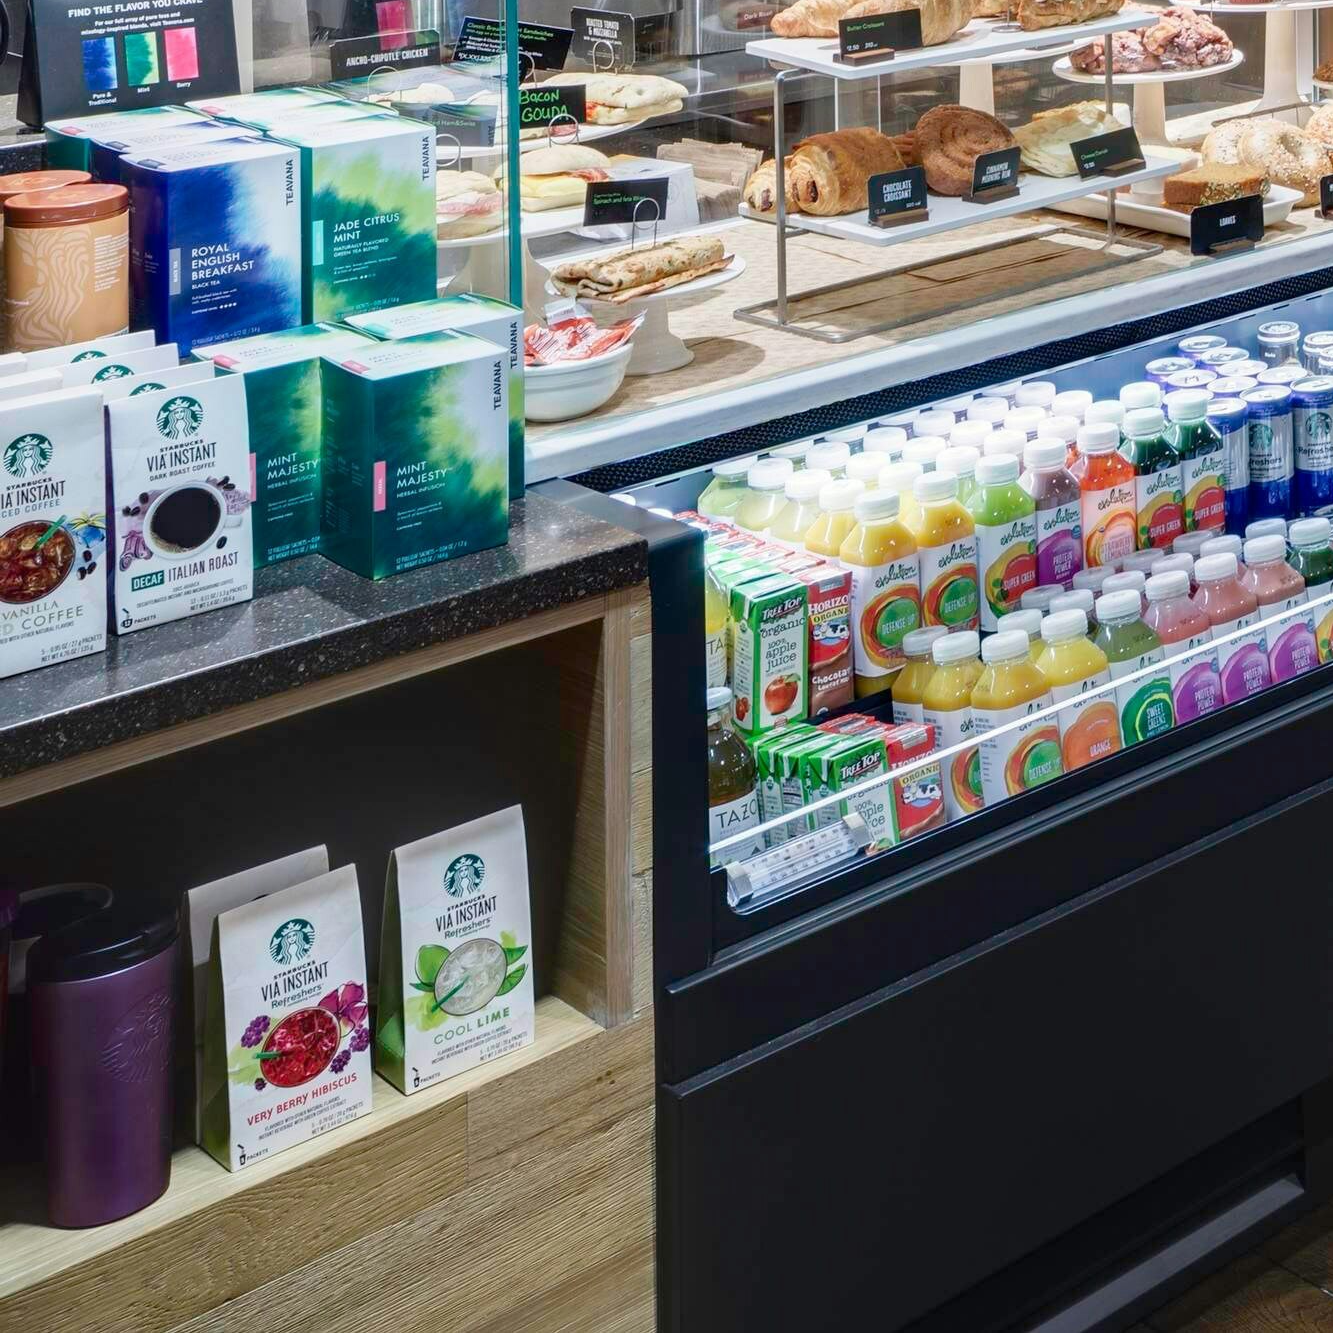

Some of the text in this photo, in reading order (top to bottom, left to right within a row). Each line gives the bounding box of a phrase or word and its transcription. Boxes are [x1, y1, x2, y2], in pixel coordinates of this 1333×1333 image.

[68, 8, 91, 18] FIND
[94, 5, 112, 15] THE
[115, 1, 150, 13] FLAVOR
[401, 47, 429, 59] CHICKEN
[522, 105, 569, 122] GOUDA
[422, 136, 430, 181] TEAVANA
[286, 159, 294, 205] TEAVANA
[882, 179, 912, 193] CHOCOLATE
[883, 189, 912, 202] CROISSANT
[333, 213, 400, 233] JADE CITRUS
[333, 231, 361, 243] MINT
[191, 243, 229, 258] ROYAL
[191, 252, 240, 270] ENGLISH
[191, 261, 254, 281] BREAKFAST
[191, 282, 209, 290] BLACK
[510, 321, 518, 369] TEAVANA
[493, 360, 501, 410] TEAVANA
[159, 439, 203, 453] STARBUCKS
[146, 442, 217, 472] VIA INSTANT
[267, 452, 298, 468] MINT
[149, 461, 216, 482] DARK ROAST COFFEE
[267, 460, 318, 481] MAJESTY
[396, 460, 427, 477] MINT
[6, 477, 52, 491] STARBUCKS
[396, 469, 447, 489] MAJESTY
[1, 480, 66, 510] IA INSTANT
[1, 499, 60, 517] CED COFFEE
[133, 552, 239, 591] DECAF ITALIAN ROAST
[1, 600, 59, 620] VANILLA
[808, 595, 849, 615] HORIZO
[944, 597, 965, 614] DEFENSE
[21, 605, 84, 630] COFFEE
[881, 617, 906, 635] DEFENSE
[760, 617, 806, 639] organic
[765, 641, 797, 660] apple
[765, 652, 797, 673] juice
[1089, 738, 1112, 756] ORANGE
[715, 799, 756, 828] TAZO
[447, 894, 485, 911] STARBUCKS
[435, 896, 497, 932] VIA INSTANT
[444, 917, 491, 939] Refreshers
[274, 961, 316, 980] STARBUCKS
[261, 961, 329, 1002] VIA INSTANT
[271, 984, 322, 1009] Refreshers
[434, 1006, 510, 1045] COOL LIME
[247, 1108, 274, 1126] VERY
[276, 1093, 309, 1113] BERRY
[311, 1072, 358, 1098] HIBISCUS
